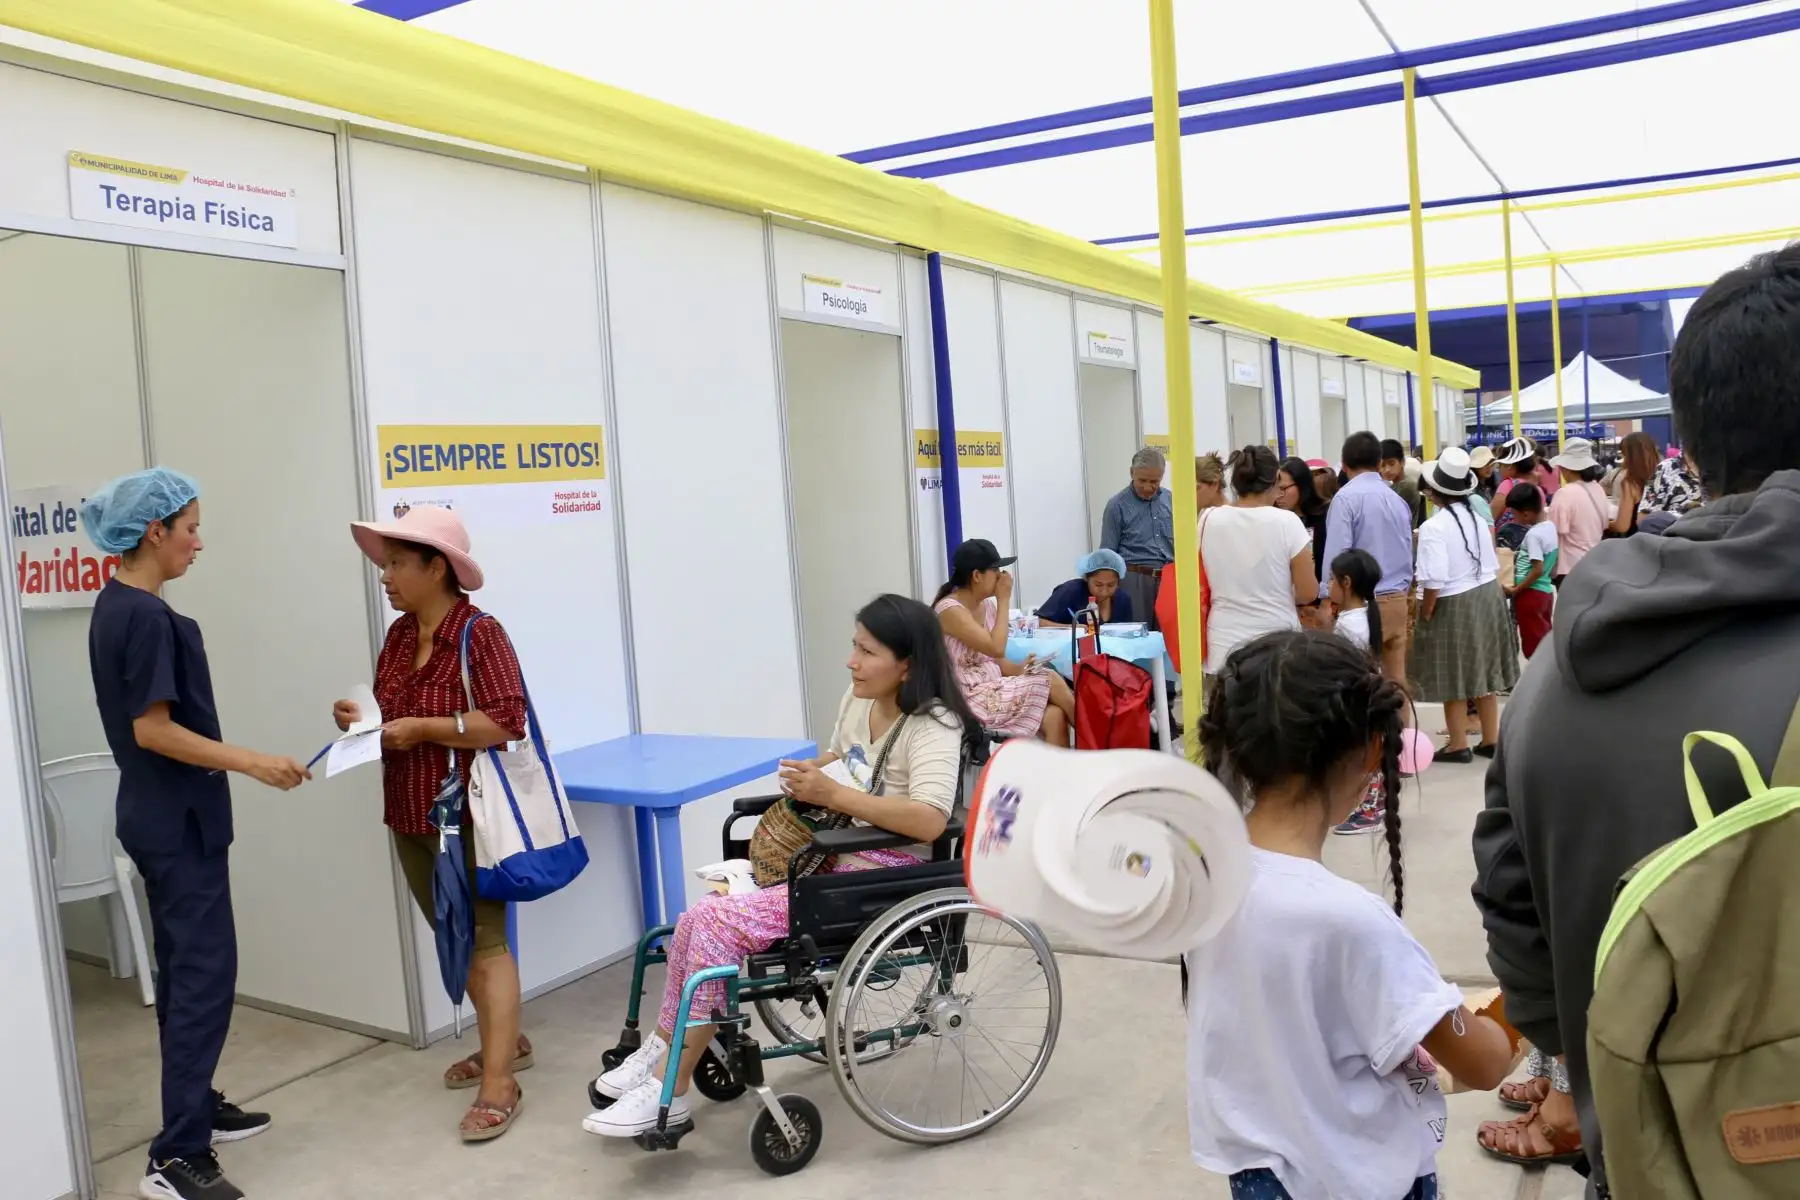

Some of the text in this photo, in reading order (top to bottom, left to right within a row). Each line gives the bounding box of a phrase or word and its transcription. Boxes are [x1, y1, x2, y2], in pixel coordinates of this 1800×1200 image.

[87, 160, 178, 181] MUNICIPALIDAD DE LIMA
[193, 175, 224, 188] Hospital
[227, 181, 236, 189] de
[246, 184, 287, 198] Solidaridad
[100, 184, 274, 232] Terapia Física
[957, 444, 967, 456] es
[968, 440, 984, 456] más
[385, 442, 600, 480] ¡SIEMPRE LISTOS!
[554, 489, 597, 500] Hospital de la
[552, 500, 601, 513] Solidaridad
[13, 501, 76, 537] ital de
